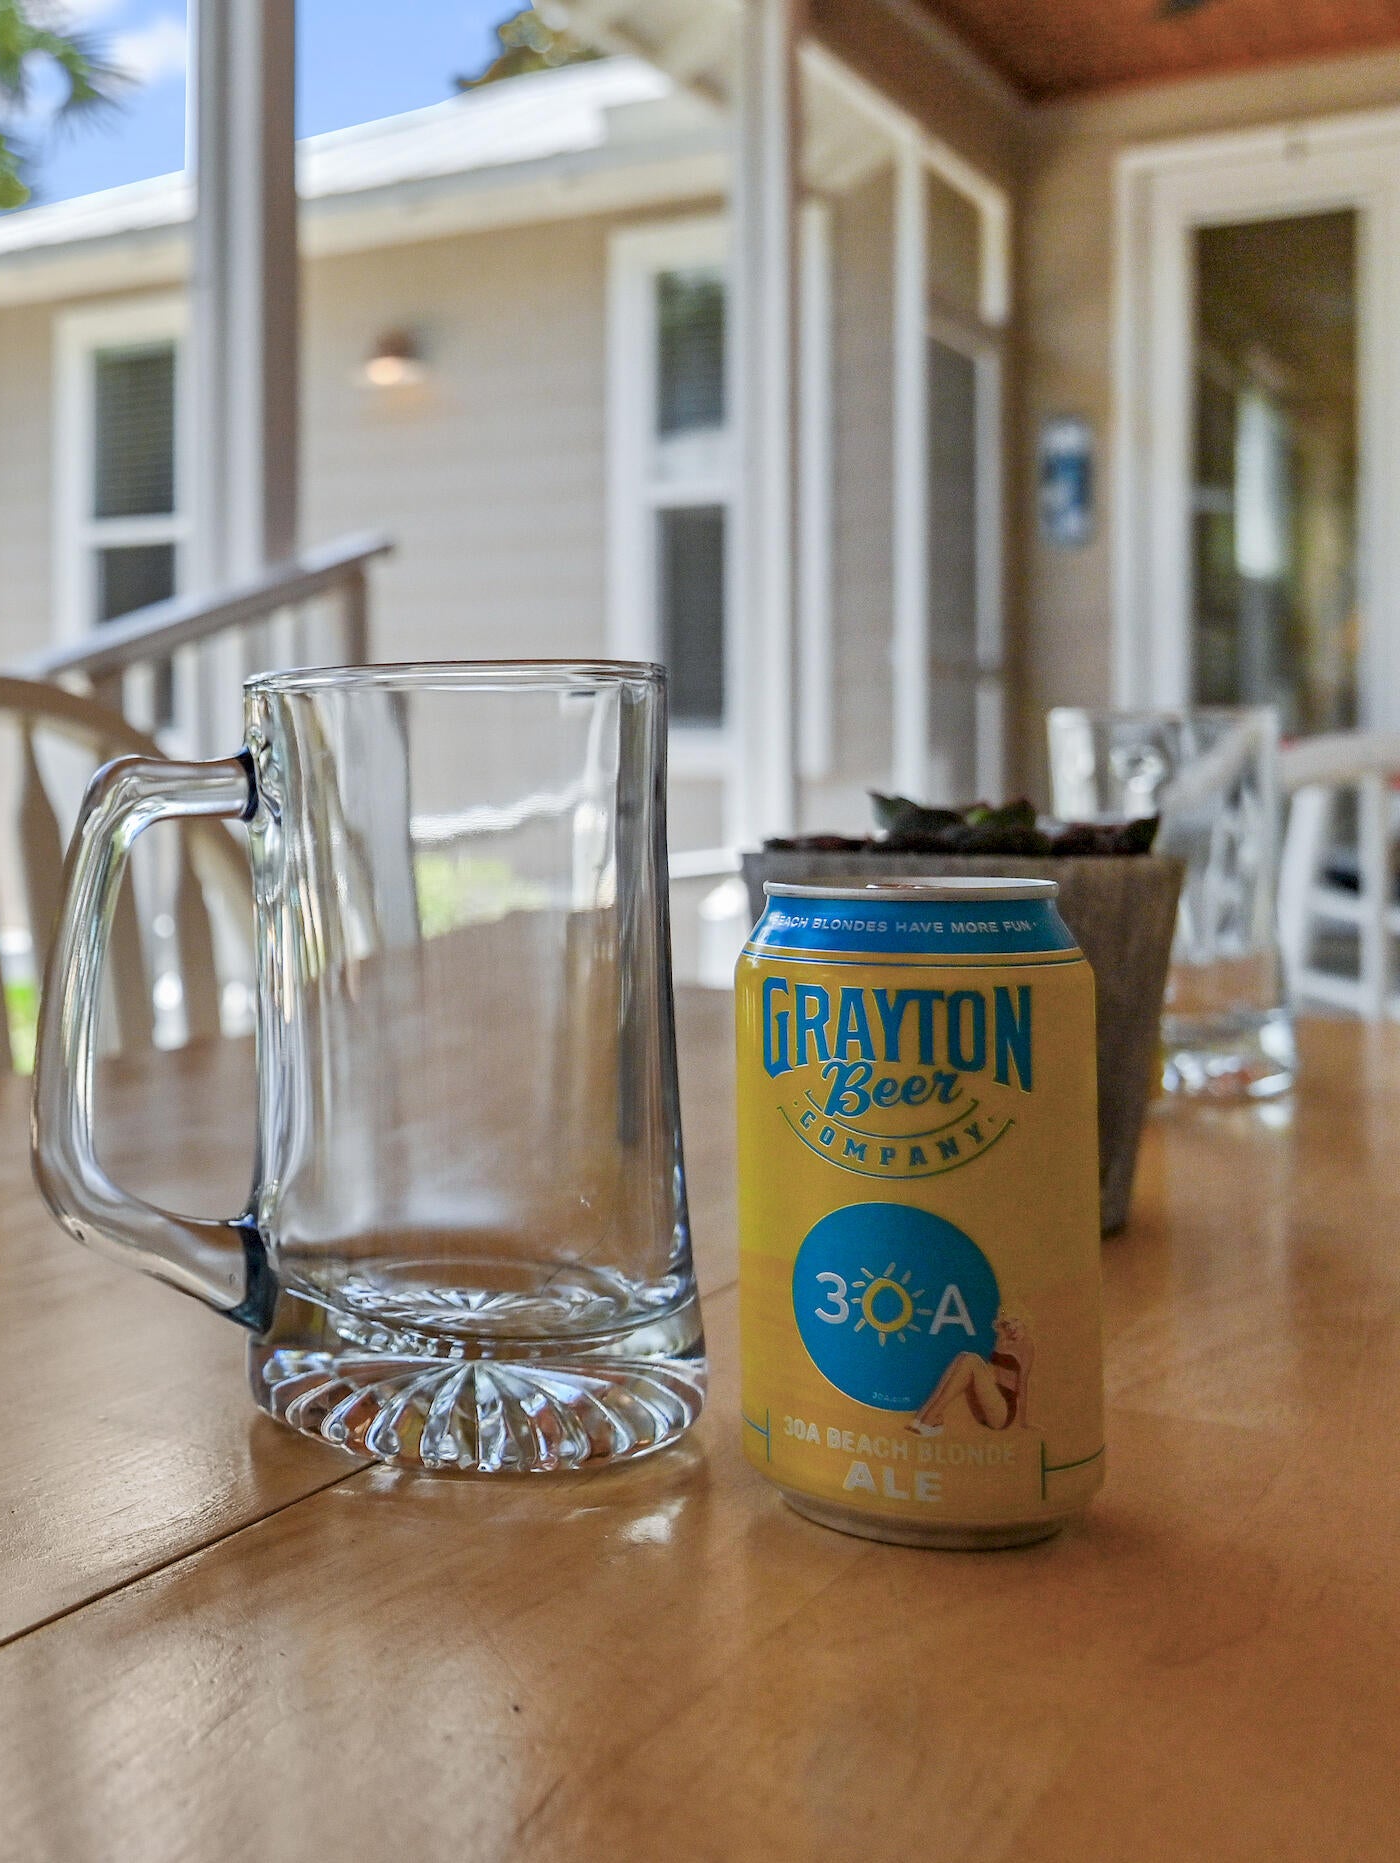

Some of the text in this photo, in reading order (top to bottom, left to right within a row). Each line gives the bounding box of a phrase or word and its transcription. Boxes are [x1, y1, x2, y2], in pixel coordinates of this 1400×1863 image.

[771, 914, 1031, 934] EACH BLONDES HAVE MORE FUN
[762, 976, 1032, 1094] GRAYTON
[821, 1061, 963, 1118] Beer
[799, 1109, 986, 1167] COMPANY
[783, 1415, 1017, 1466] 30A BEACH BLONDE
[842, 1460, 943, 1502] ALE
